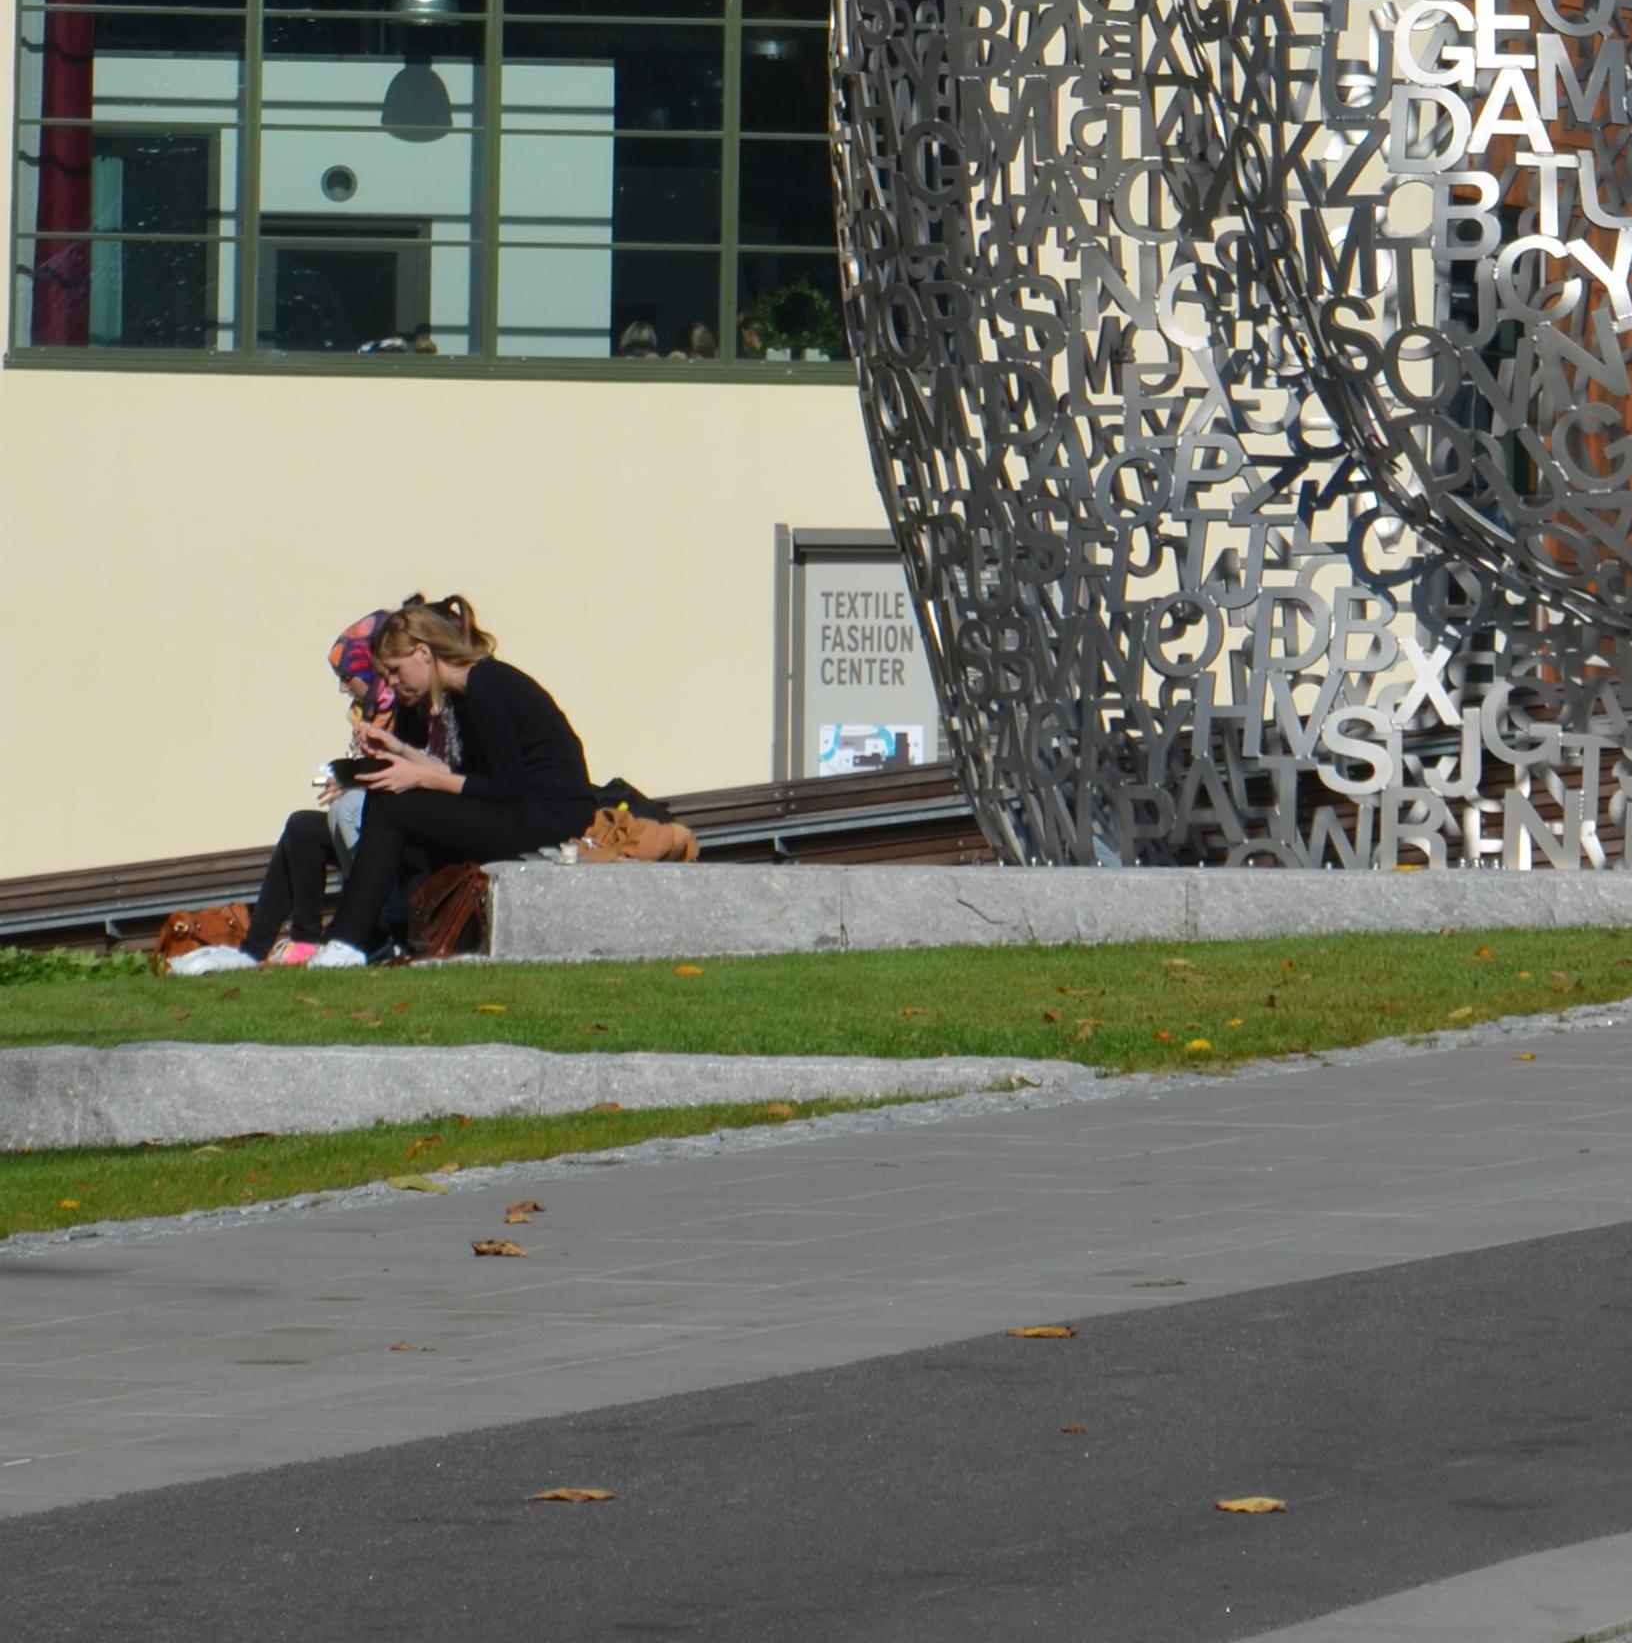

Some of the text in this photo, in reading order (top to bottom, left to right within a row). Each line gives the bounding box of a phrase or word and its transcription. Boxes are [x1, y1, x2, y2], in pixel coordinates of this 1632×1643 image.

[820, 591, 904, 619] TEXTILE
[821, 625, 914, 653] FASHION
[820, 658, 905, 686] CENTER
